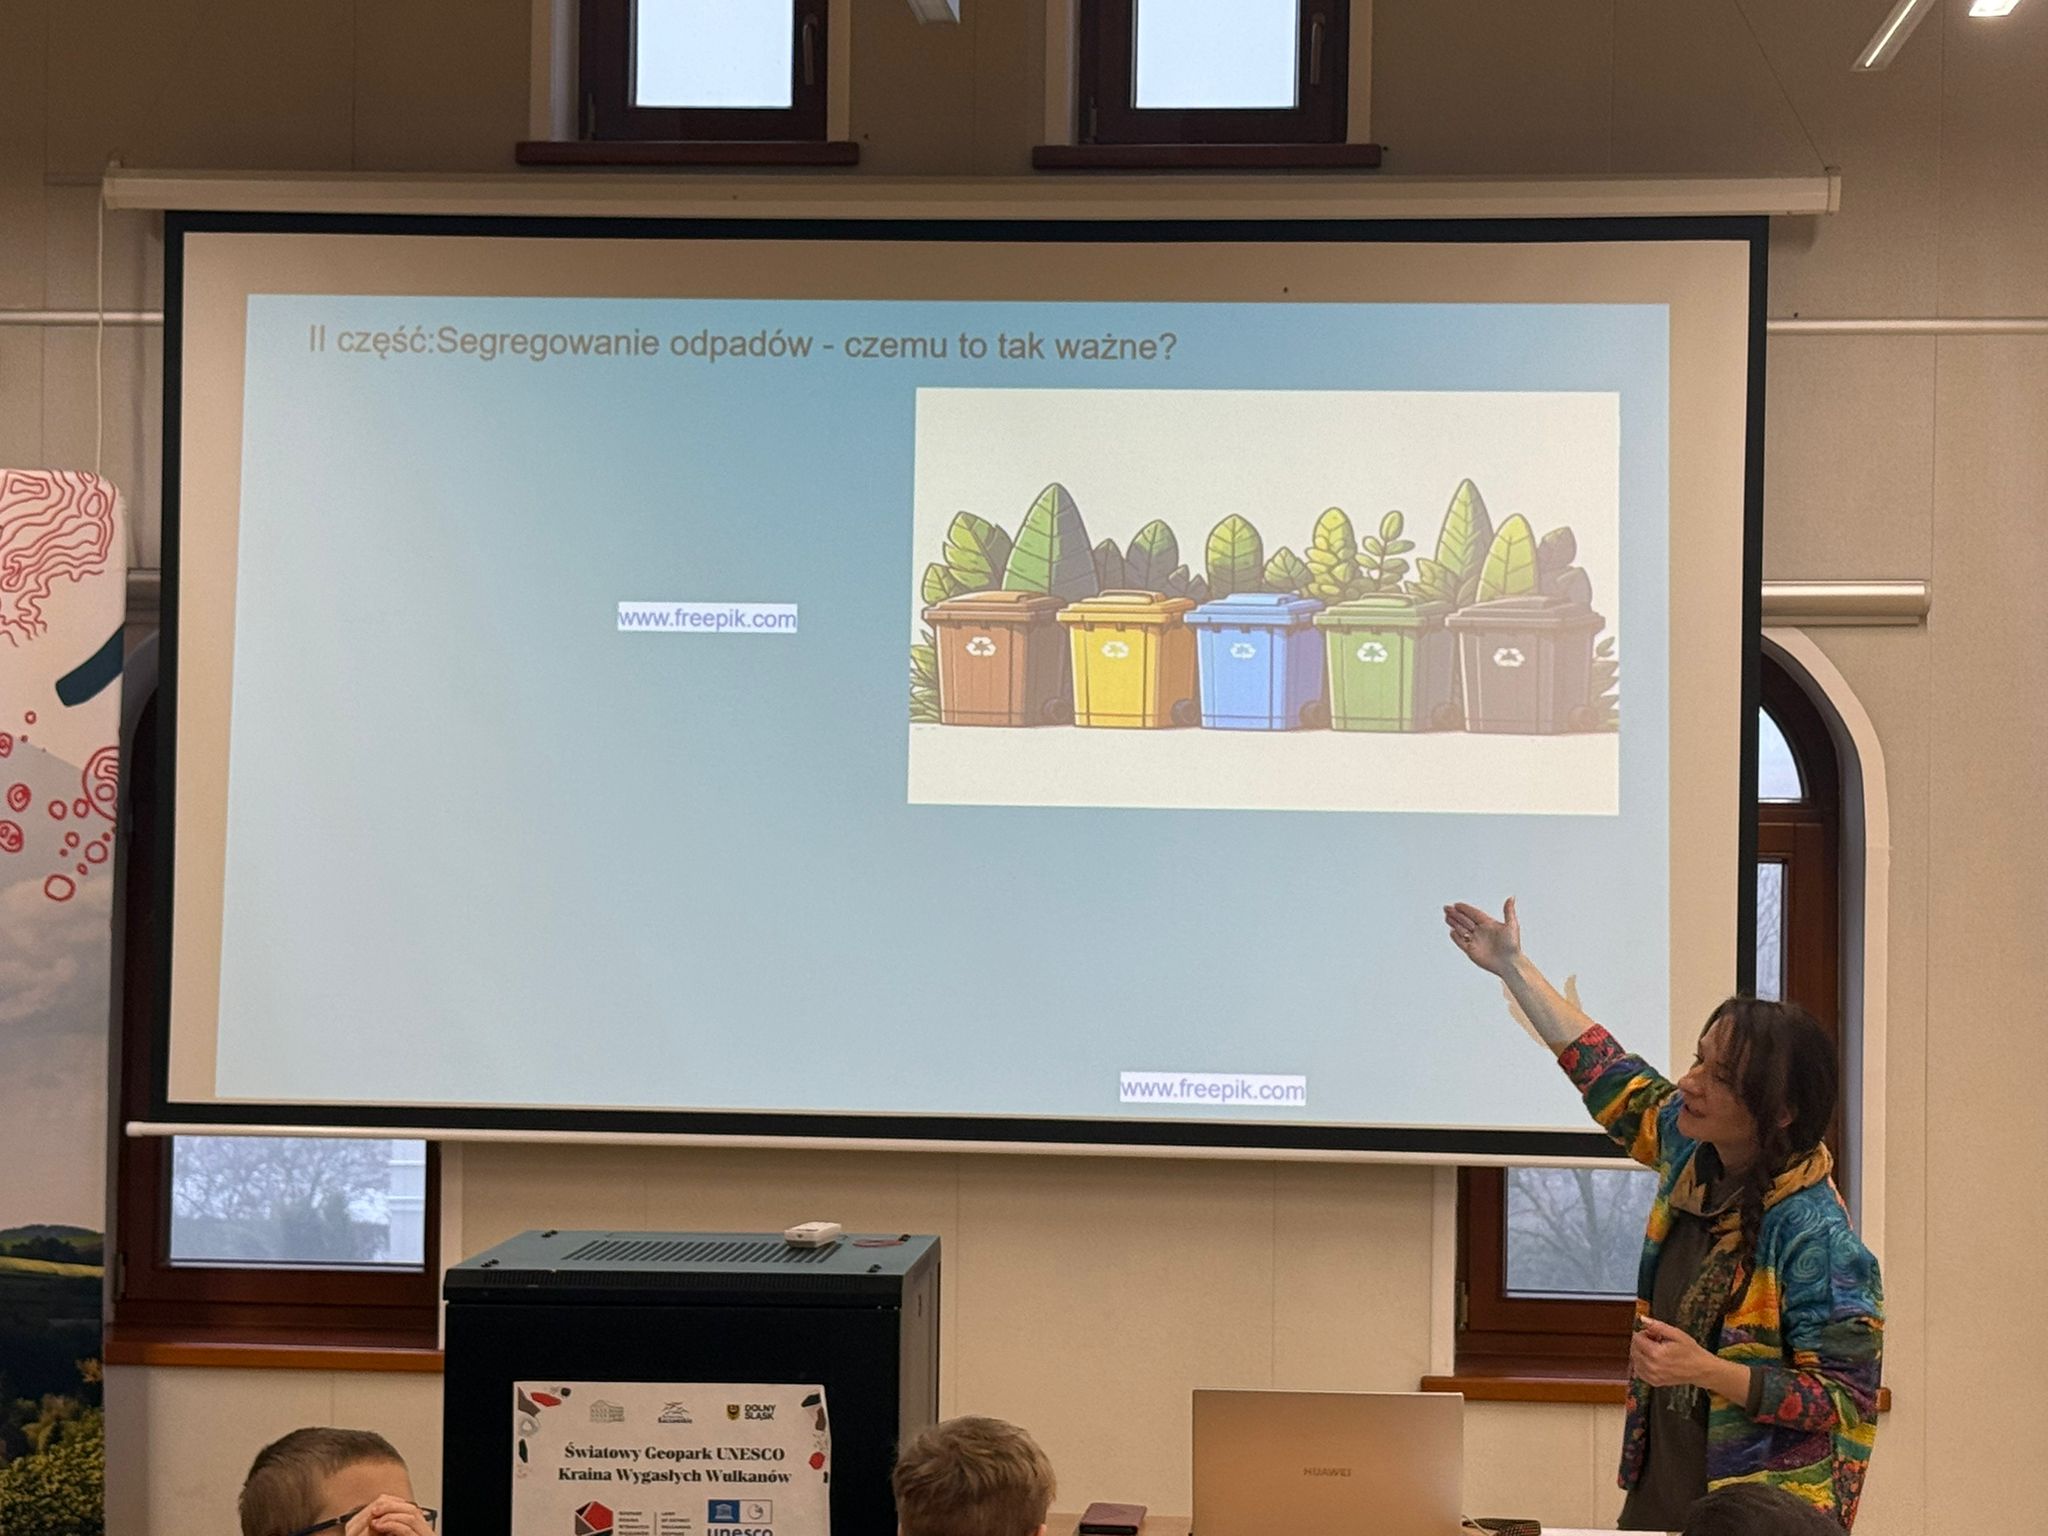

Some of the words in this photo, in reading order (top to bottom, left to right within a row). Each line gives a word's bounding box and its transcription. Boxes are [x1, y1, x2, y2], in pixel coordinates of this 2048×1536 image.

[309, 324, 326, 353] II
[337, 323, 660, 361] część:Segregowanie
[670, 328, 813, 363] odpadów
[844, 333, 948, 358] czemu
[959, 333, 988, 359] to
[999, 332, 1044, 360] tak
[1056, 332, 1177, 362] ważne?
[619, 607, 797, 632] www.freepik.com
[1121, 1078, 1305, 1103] www.freepik.com
[744, 1404, 776, 1412] DOLNY
[564, 1441, 641, 1463] Światowy
[645, 1446, 712, 1463] Geopark
[716, 1447, 785, 1461] UNESCO
[559, 1466, 612, 1481] Kraina
[616, 1468, 702, 1485] Wygasłych
[706, 1468, 792, 1483] Wulkanów
[1303, 1467, 1352, 1477] HUAWEI
